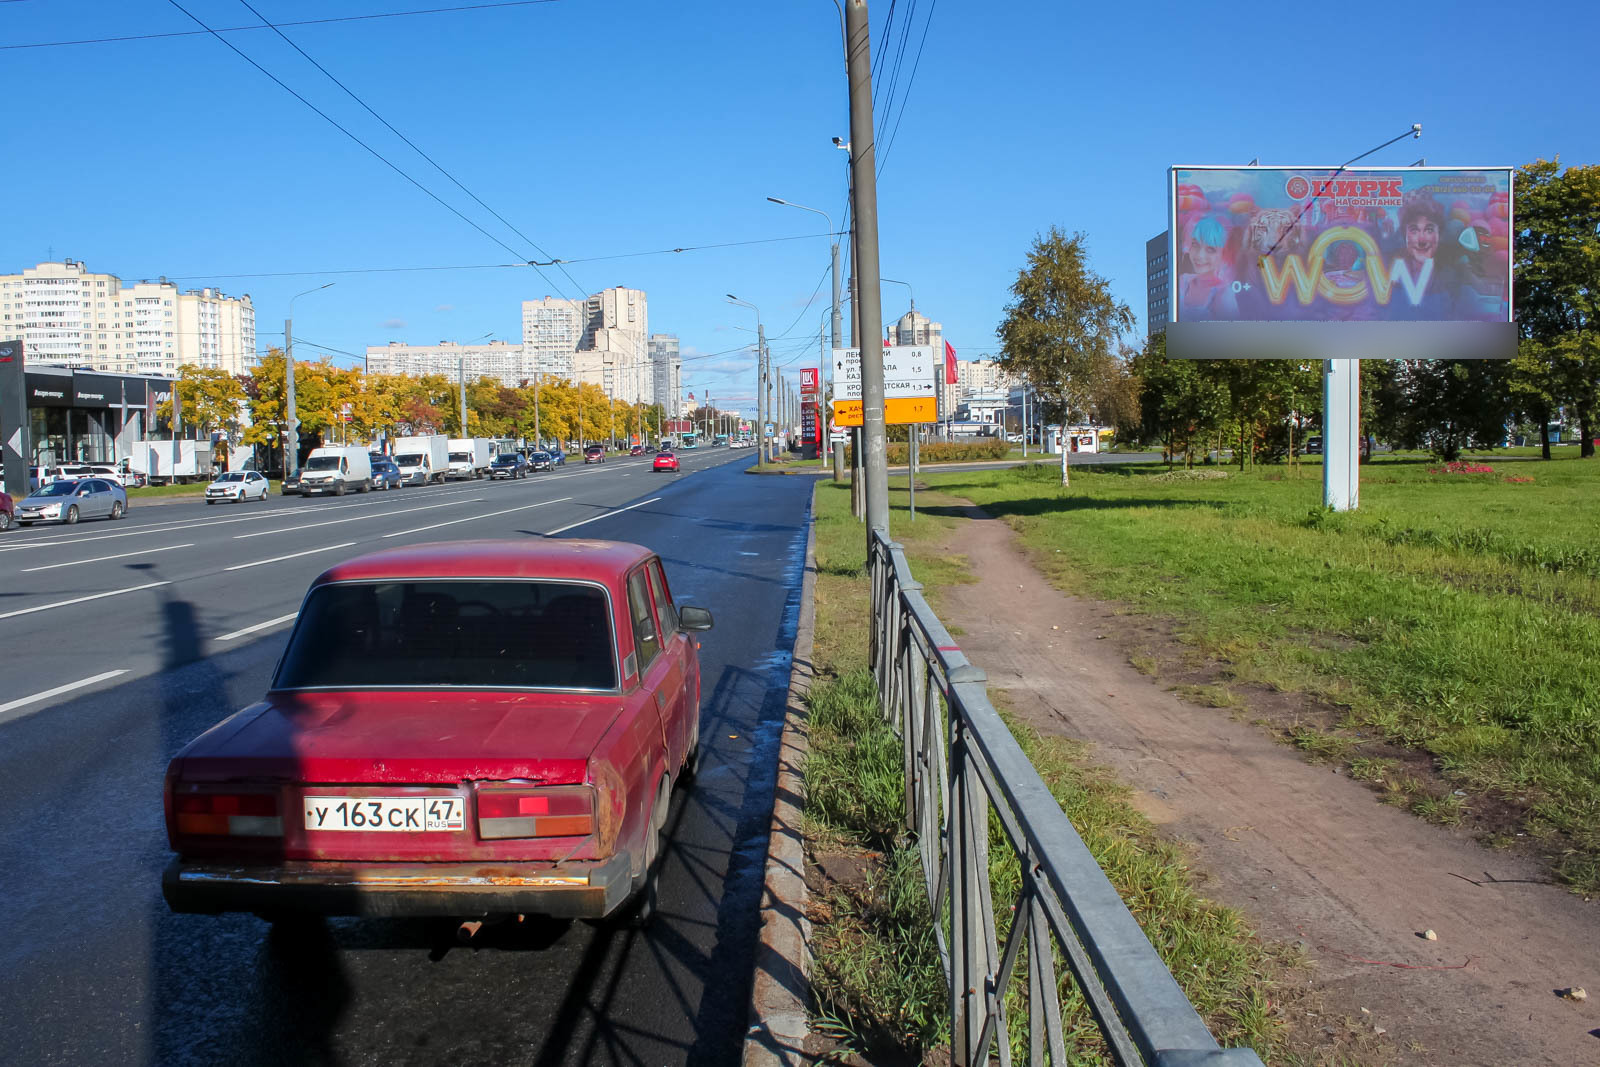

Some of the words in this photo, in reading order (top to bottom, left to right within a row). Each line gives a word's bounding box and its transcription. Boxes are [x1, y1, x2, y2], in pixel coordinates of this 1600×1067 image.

[1311, 180, 1402, 200] ЦИРК
[1336, 198, 1350, 207] НА
[1351, 198, 1402, 207] ФОНТАНКЕ
[1260, 226, 1434, 305] WOW
[1231, 279, 1252, 294] 0+
[911, 366, 922, 374] 1,5
[428, 800, 454, 820] 47
[427, 820, 447, 829] RUS
